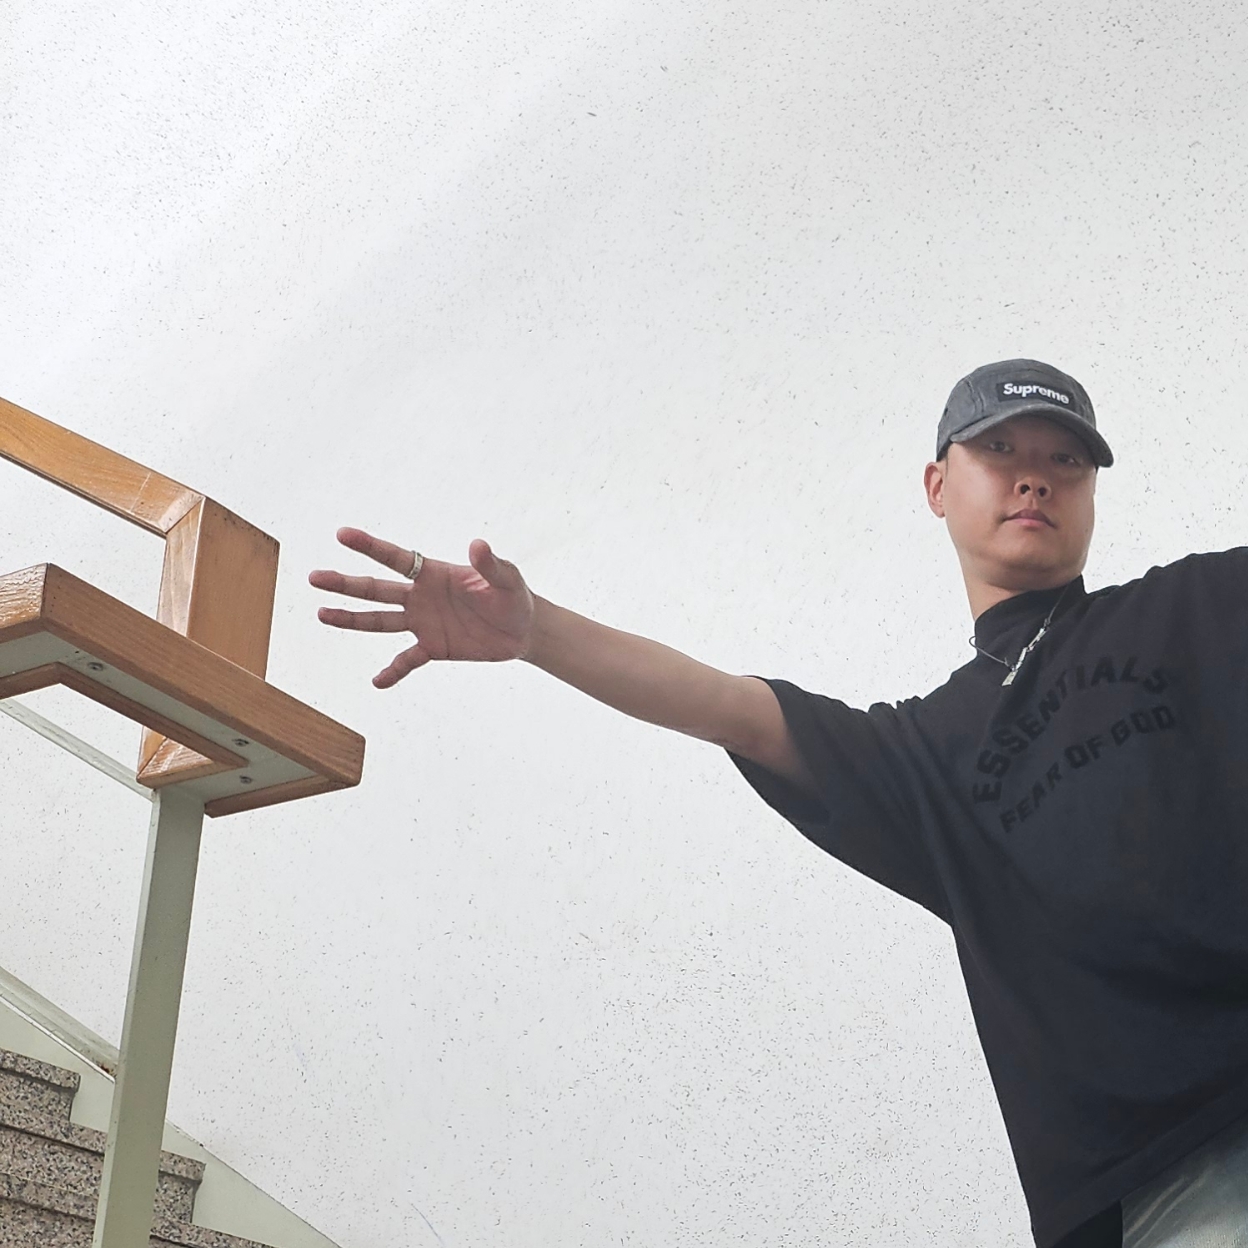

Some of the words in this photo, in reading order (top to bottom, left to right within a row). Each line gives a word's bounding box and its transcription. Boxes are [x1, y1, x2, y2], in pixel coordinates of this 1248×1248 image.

[1003, 382, 1070, 404] Supreme
[973, 656, 1168, 804] ESSENTIALS
[1001, 762, 1063, 833] FEAR
[1063, 735, 1103, 770] OF
[1110, 705, 1177, 747] GOD
